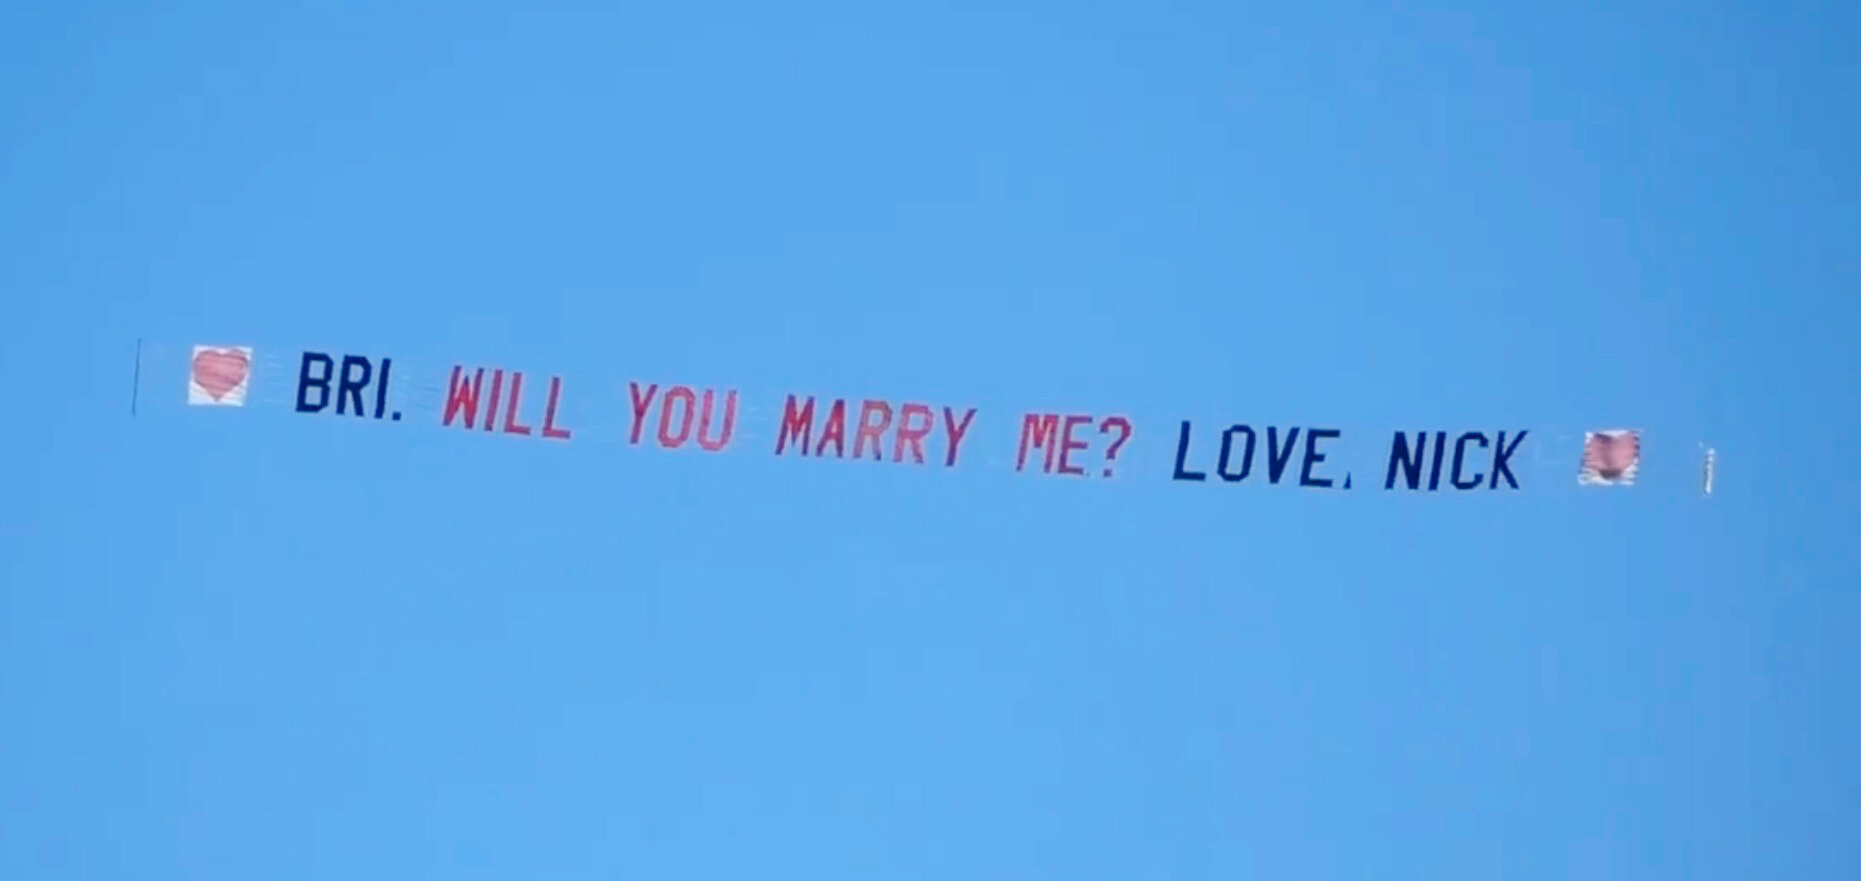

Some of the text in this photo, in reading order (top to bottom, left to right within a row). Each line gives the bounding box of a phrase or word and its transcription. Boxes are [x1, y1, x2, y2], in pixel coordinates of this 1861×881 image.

[294, 351, 402, 422] BRI.
[441, 365, 572, 440] WILL
[628, 382, 738, 453] YOU
[774, 394, 977, 468] MARRY
[1015, 413, 1133, 478] ME?
[1384, 429, 1530, 492] NICK
